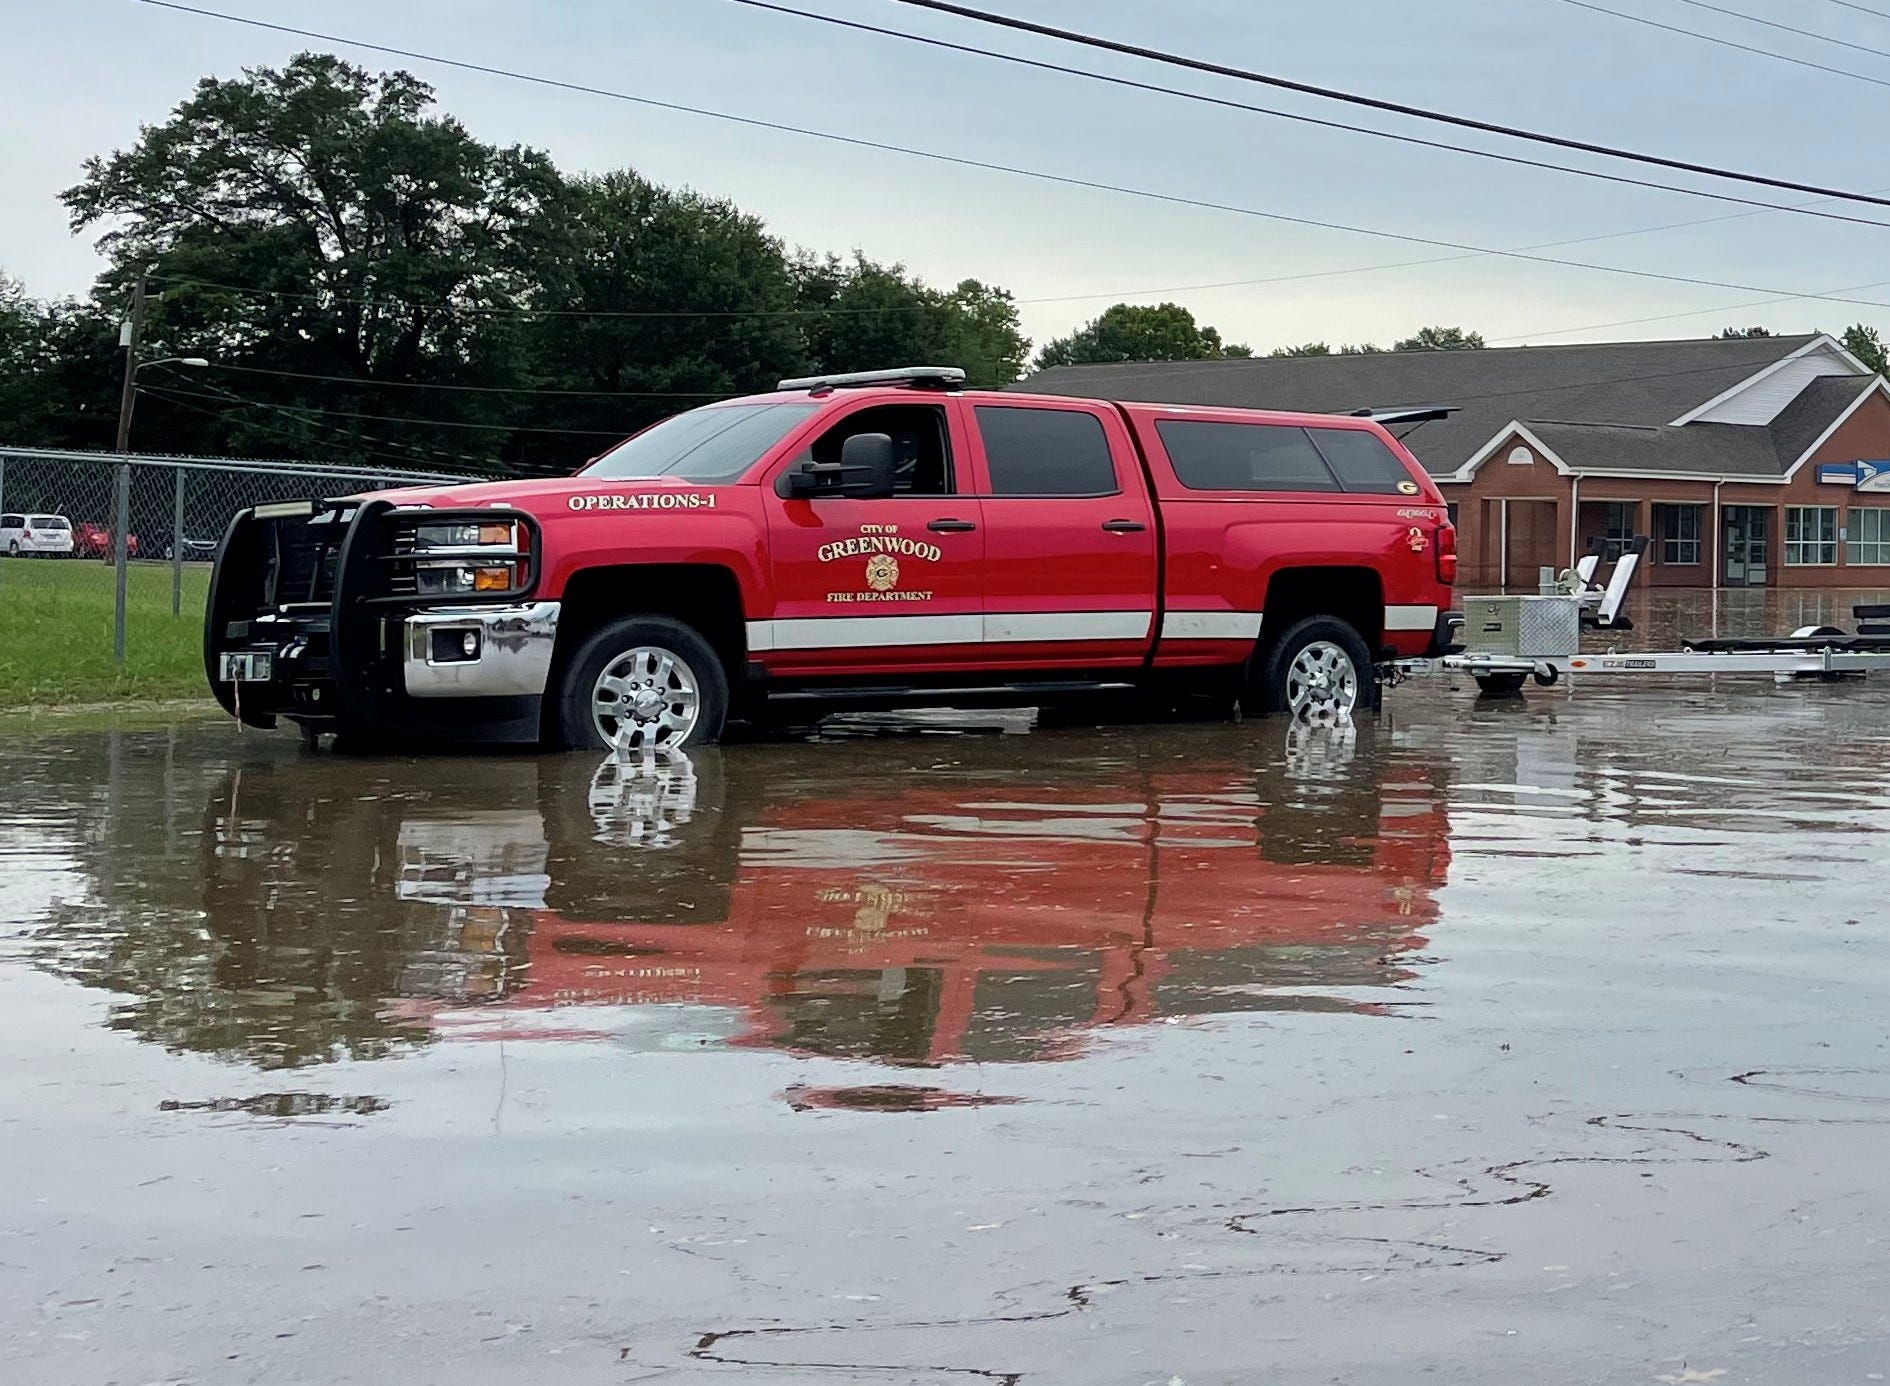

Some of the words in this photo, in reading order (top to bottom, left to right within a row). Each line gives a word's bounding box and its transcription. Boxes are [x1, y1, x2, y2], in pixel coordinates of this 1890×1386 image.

[568, 494, 716, 511] OPERATIONS-1
[860, 524, 883, 534] CITY
[885, 524, 899, 534] OF
[817, 536, 942, 562] GREENWOOD
[826, 592, 855, 602] FIRE
[856, 591, 933, 601] DEPARTMENT
